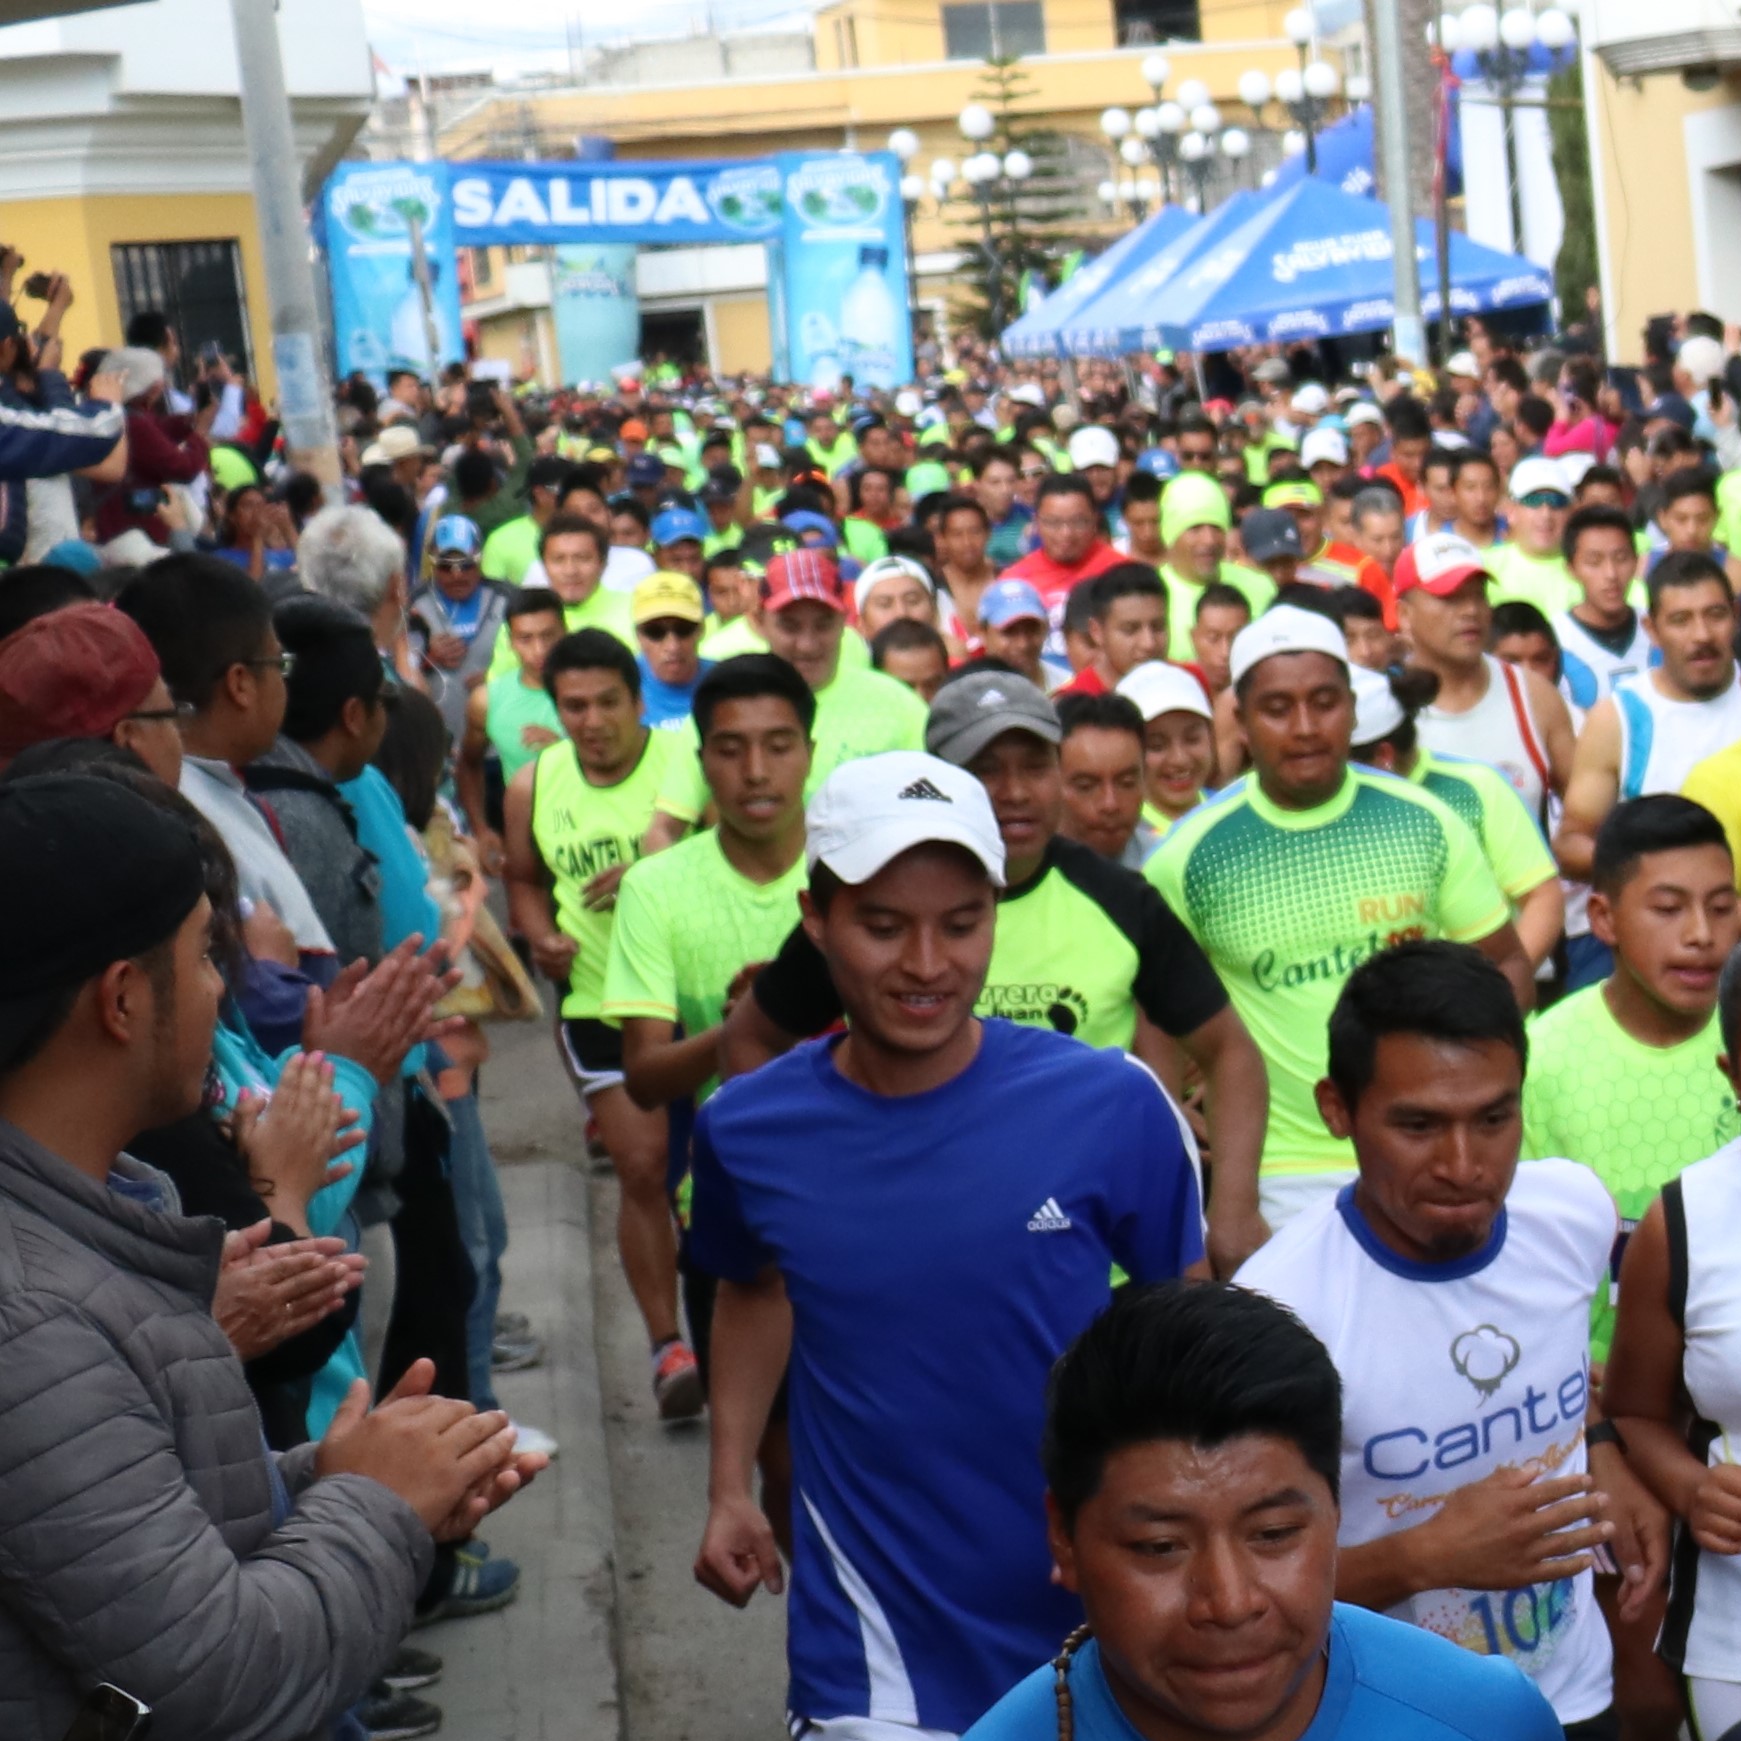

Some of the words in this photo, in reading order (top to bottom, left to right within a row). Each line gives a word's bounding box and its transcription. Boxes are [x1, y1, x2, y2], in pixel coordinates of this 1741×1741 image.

[452, 177, 710, 227] SALIDA
[981, 984, 1059, 1006] rrera
[1027, 1217, 1071, 1232] adidas
